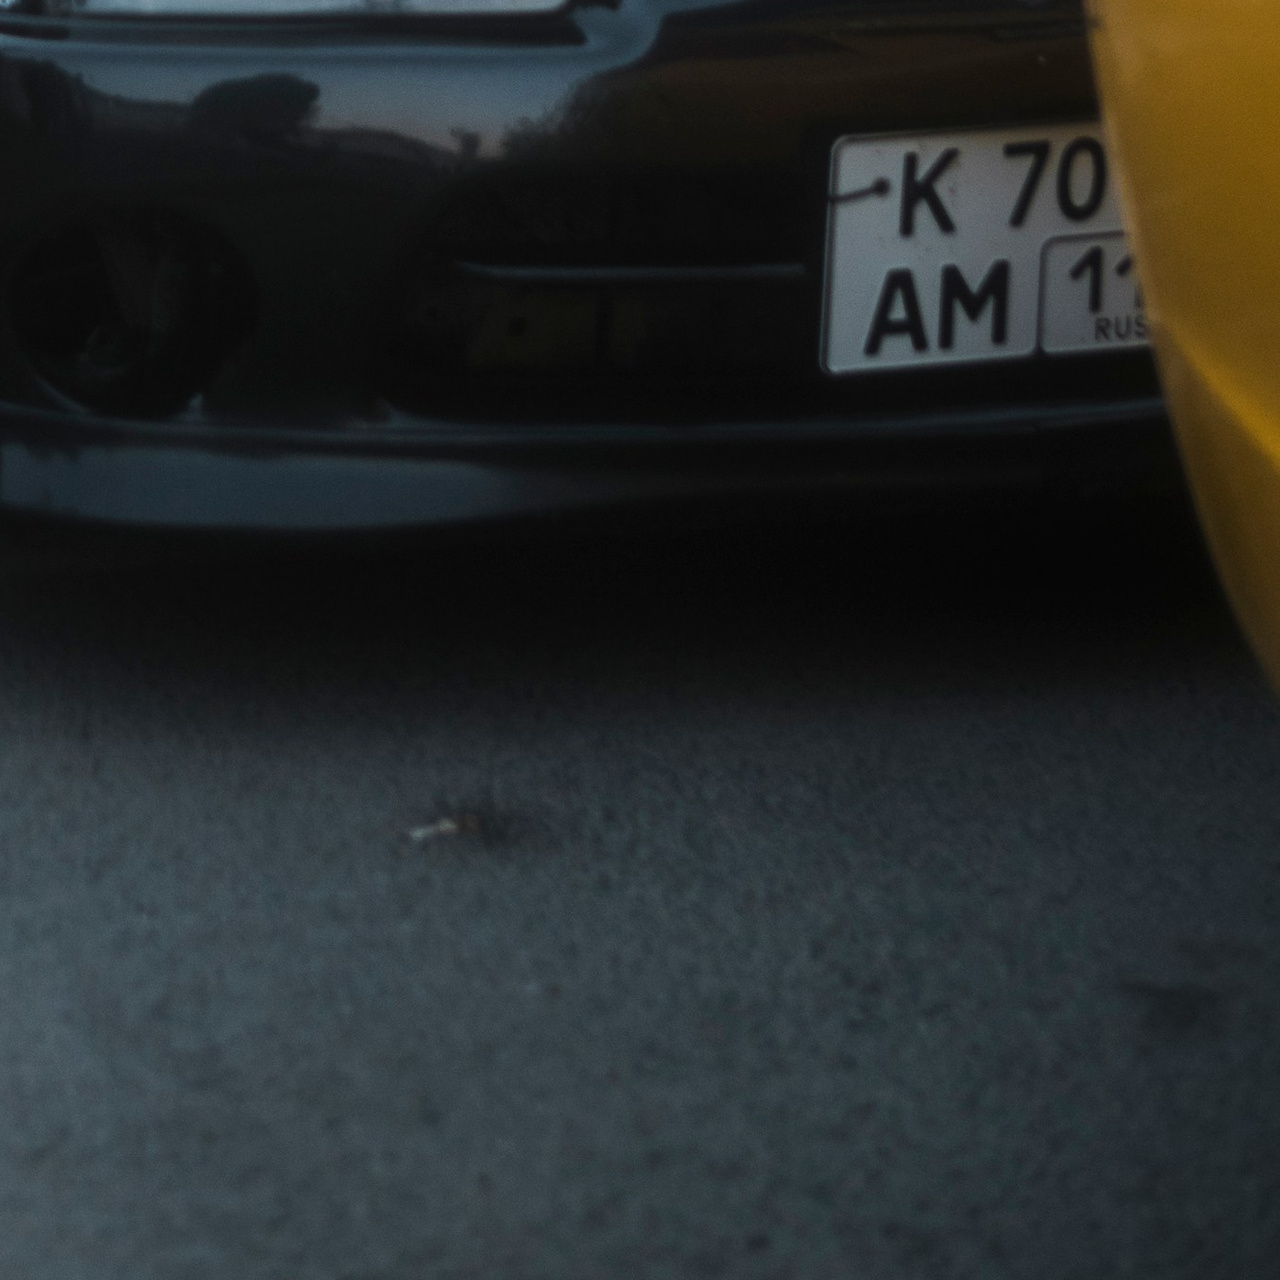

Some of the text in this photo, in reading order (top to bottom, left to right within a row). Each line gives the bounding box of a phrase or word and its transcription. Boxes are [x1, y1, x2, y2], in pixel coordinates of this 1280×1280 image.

[898, 146, 960, 238] K
[864, 258, 1010, 356] AM
[1093, 314, 1150, 342] RUS
